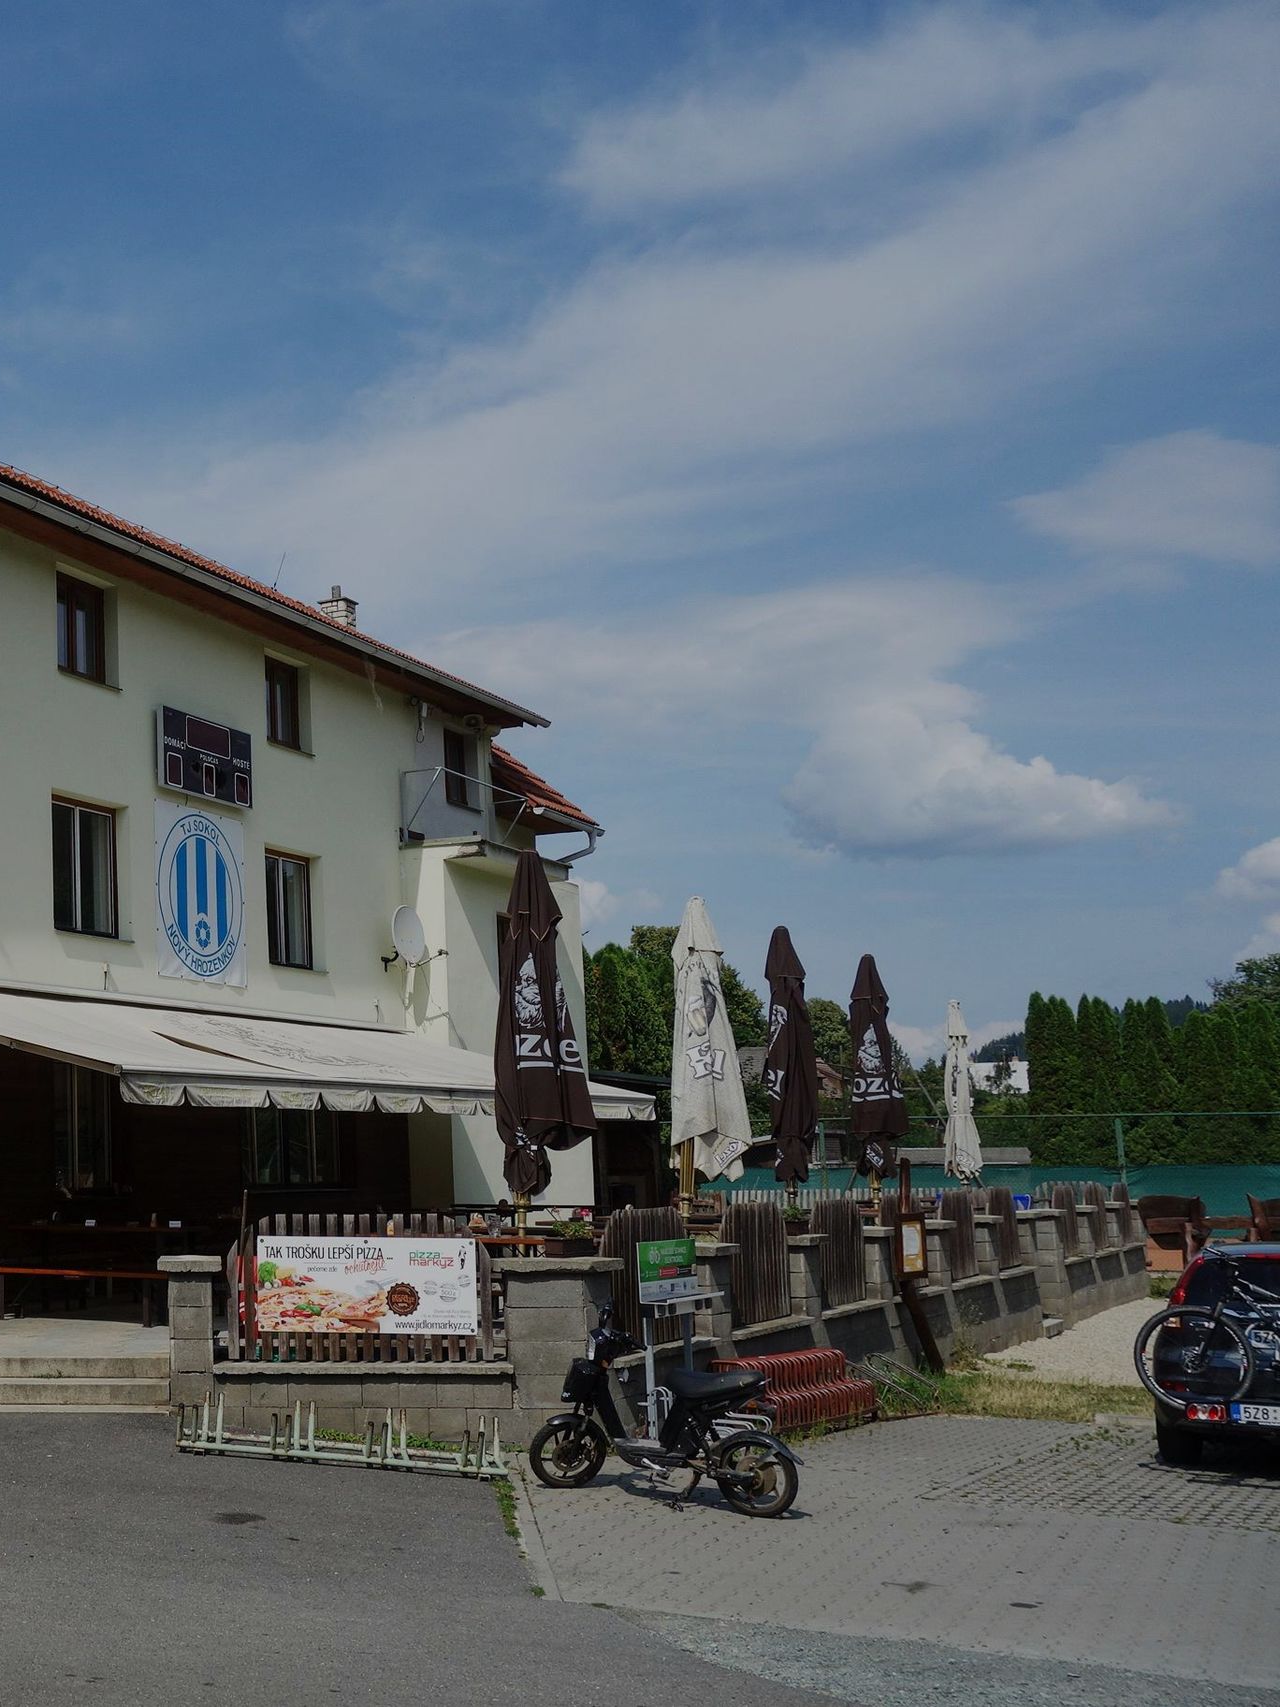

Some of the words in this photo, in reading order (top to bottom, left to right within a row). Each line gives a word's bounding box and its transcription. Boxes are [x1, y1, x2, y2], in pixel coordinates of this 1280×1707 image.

[180, 823, 191, 835] TJ
[193, 820, 221, 846] SOKOL
[167, 923, 190, 960] NOVÝ
[191, 934, 236, 974] HROZENKOV
[264, 1246, 282, 1259] TAK
[286, 1243, 325, 1260] TROŠKU
[327, 1243, 354, 1260] LEPŠÍ
[357, 1247, 384, 1260] PIZZA
[409, 1250, 441, 1261] pizza
[409, 1259, 454, 1269] markyz
[1243, 1406, 1270, 1420] 5Z8
